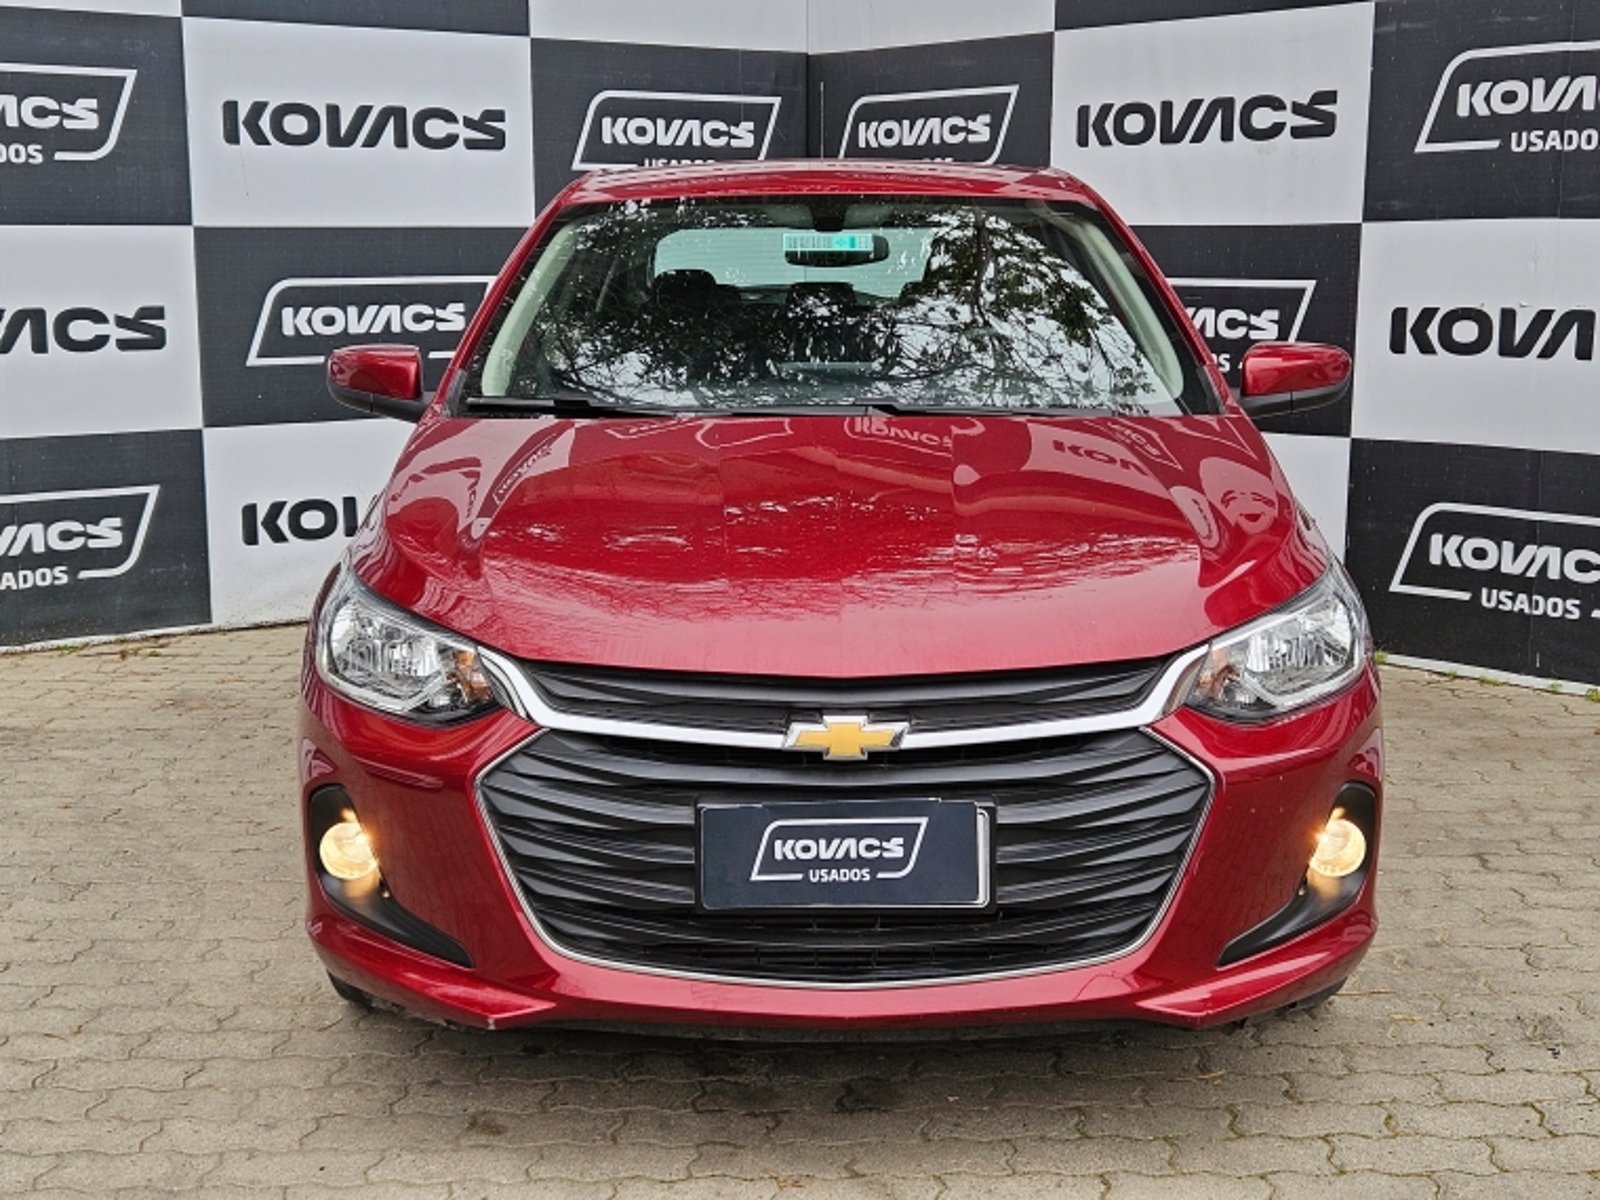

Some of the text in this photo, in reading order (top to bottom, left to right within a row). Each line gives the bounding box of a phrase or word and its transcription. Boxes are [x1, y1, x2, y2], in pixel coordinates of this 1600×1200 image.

[1457, 75, 1600, 117] KOVA
[223, 100, 506, 150] KOVACS
[602, 117, 754, 148] KOVACS
[858, 114, 990, 149] KOVACS
[1076, 90, 1338, 147] KOVACS
[1511, 128, 1600, 152] USADO
[0, 305, 167, 354] ACS
[281, 303, 465, 337] KOVACS
[1185, 307, 1279, 340] ACS
[1480, 587, 1581, 620] USADOS
[774, 837, 904, 861] KOVACS
[808, 868, 871, 883] USADOS
